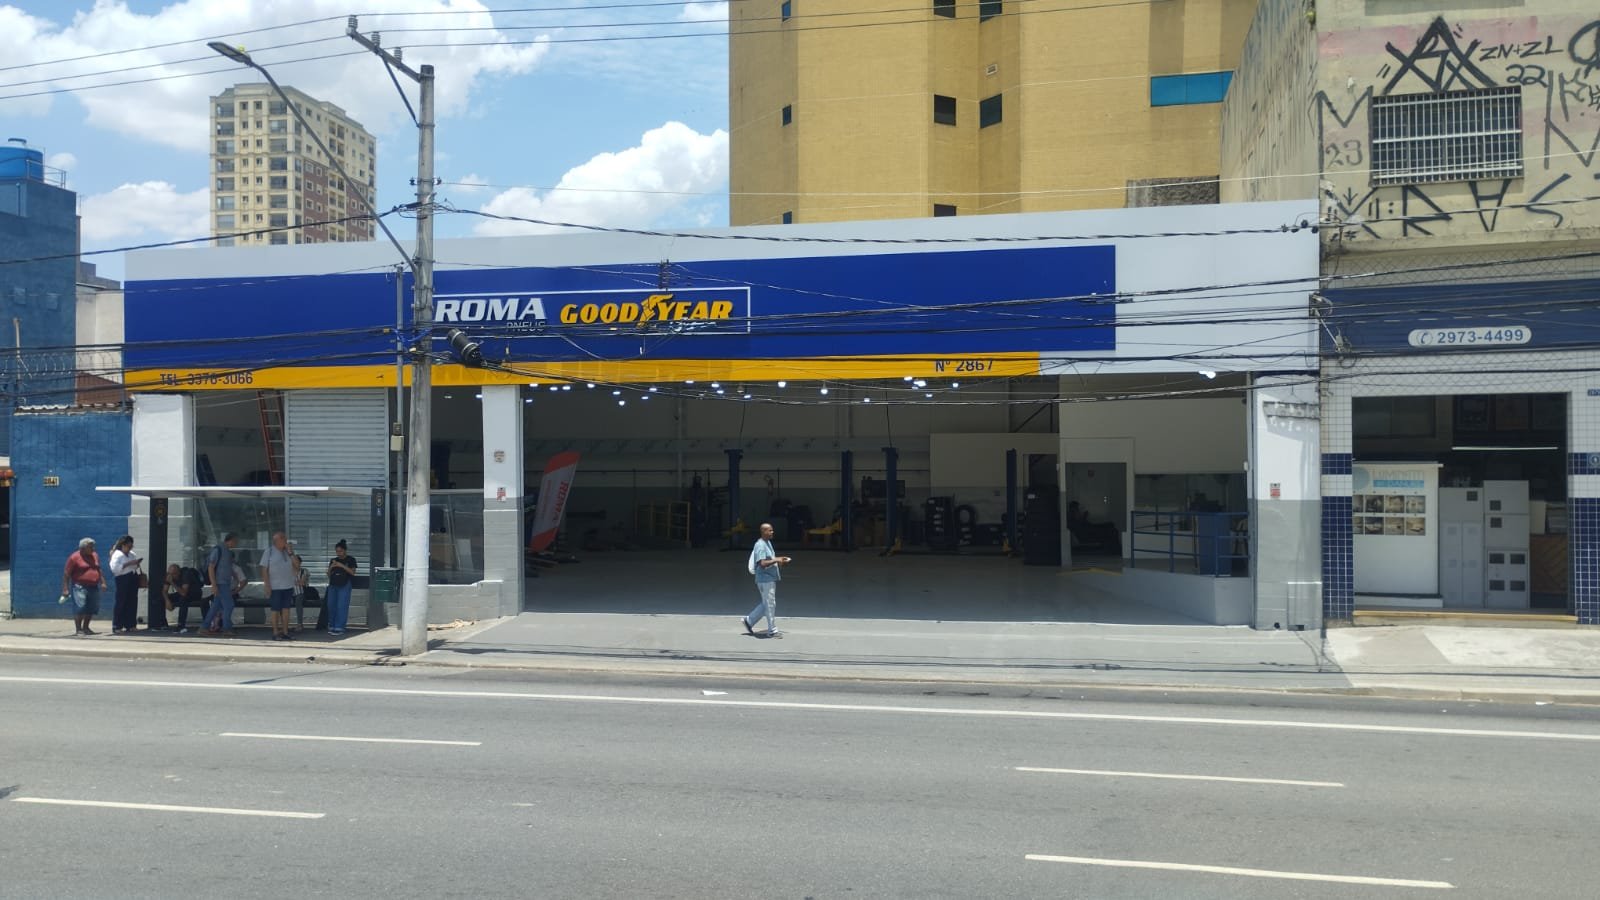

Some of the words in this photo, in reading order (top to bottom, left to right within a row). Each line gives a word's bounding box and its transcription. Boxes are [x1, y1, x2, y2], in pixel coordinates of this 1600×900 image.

[434, 297, 548, 322] ROMA
[1437, 329, 1524, 344] 2973-4499
[955, 358, 993, 372] 2867
